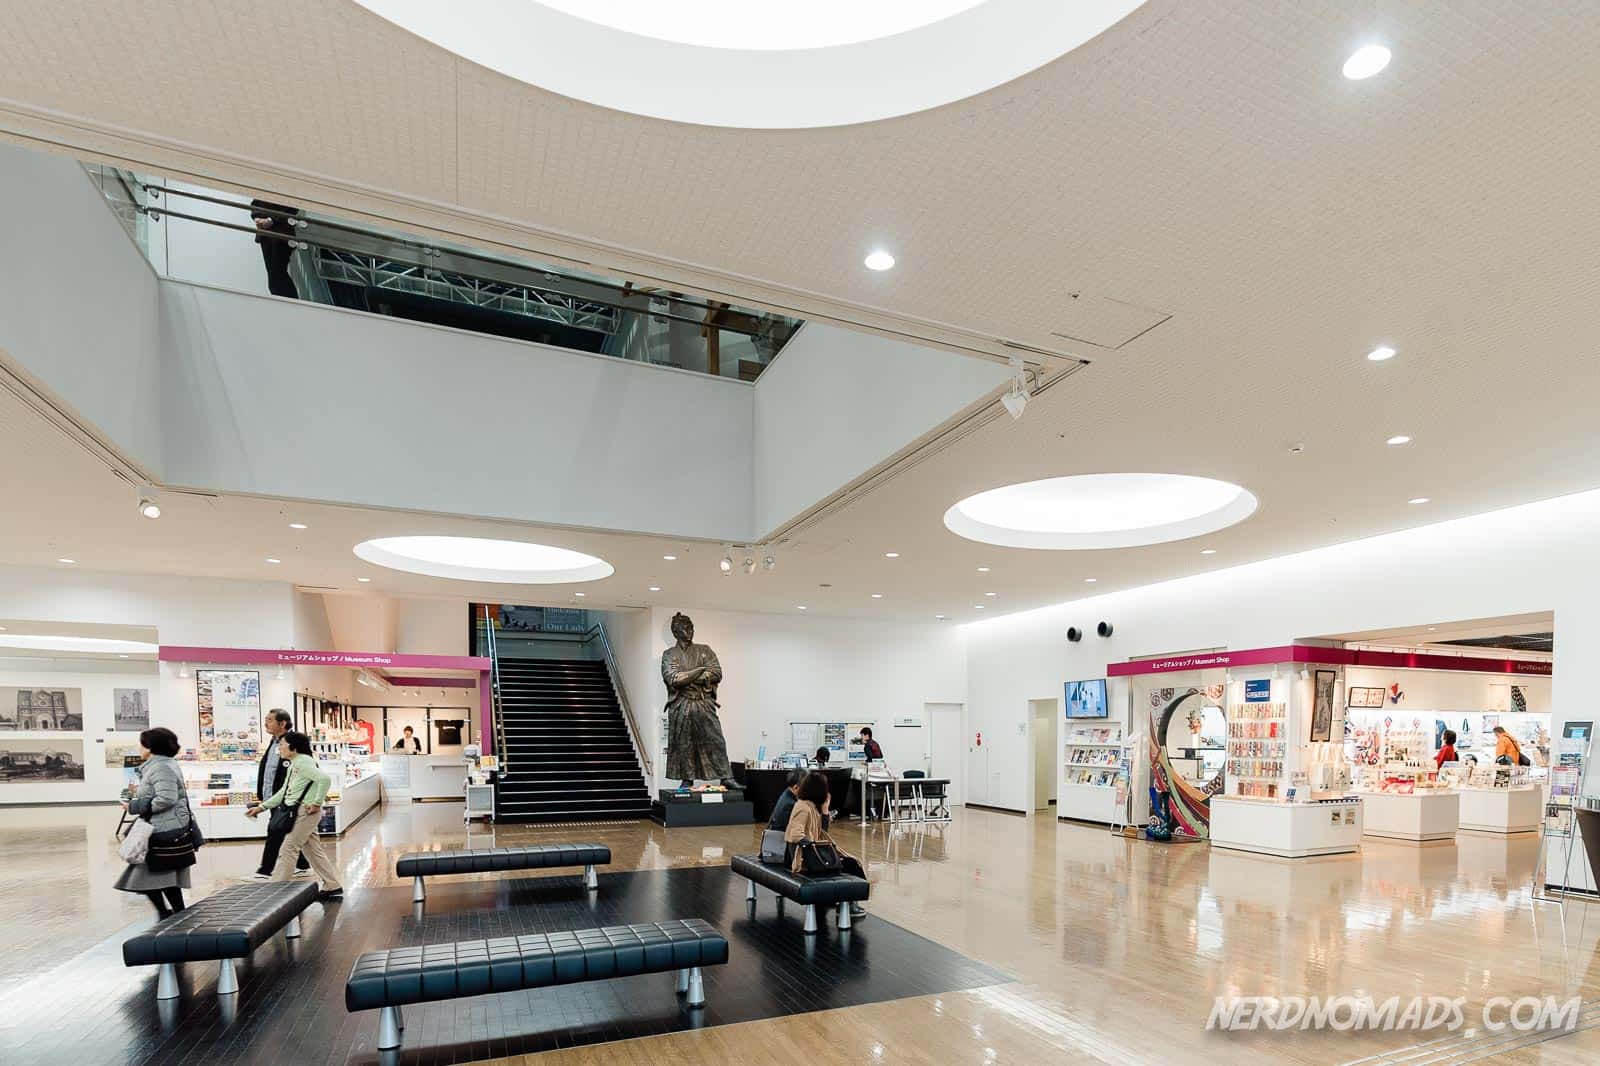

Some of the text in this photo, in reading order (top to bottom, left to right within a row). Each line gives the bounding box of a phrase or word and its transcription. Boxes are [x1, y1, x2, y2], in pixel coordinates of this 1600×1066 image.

[278, 653, 338, 662] ミュージアムショップ
[374, 656, 391, 664] Shop
[1215, 656, 1230, 664] Shop
